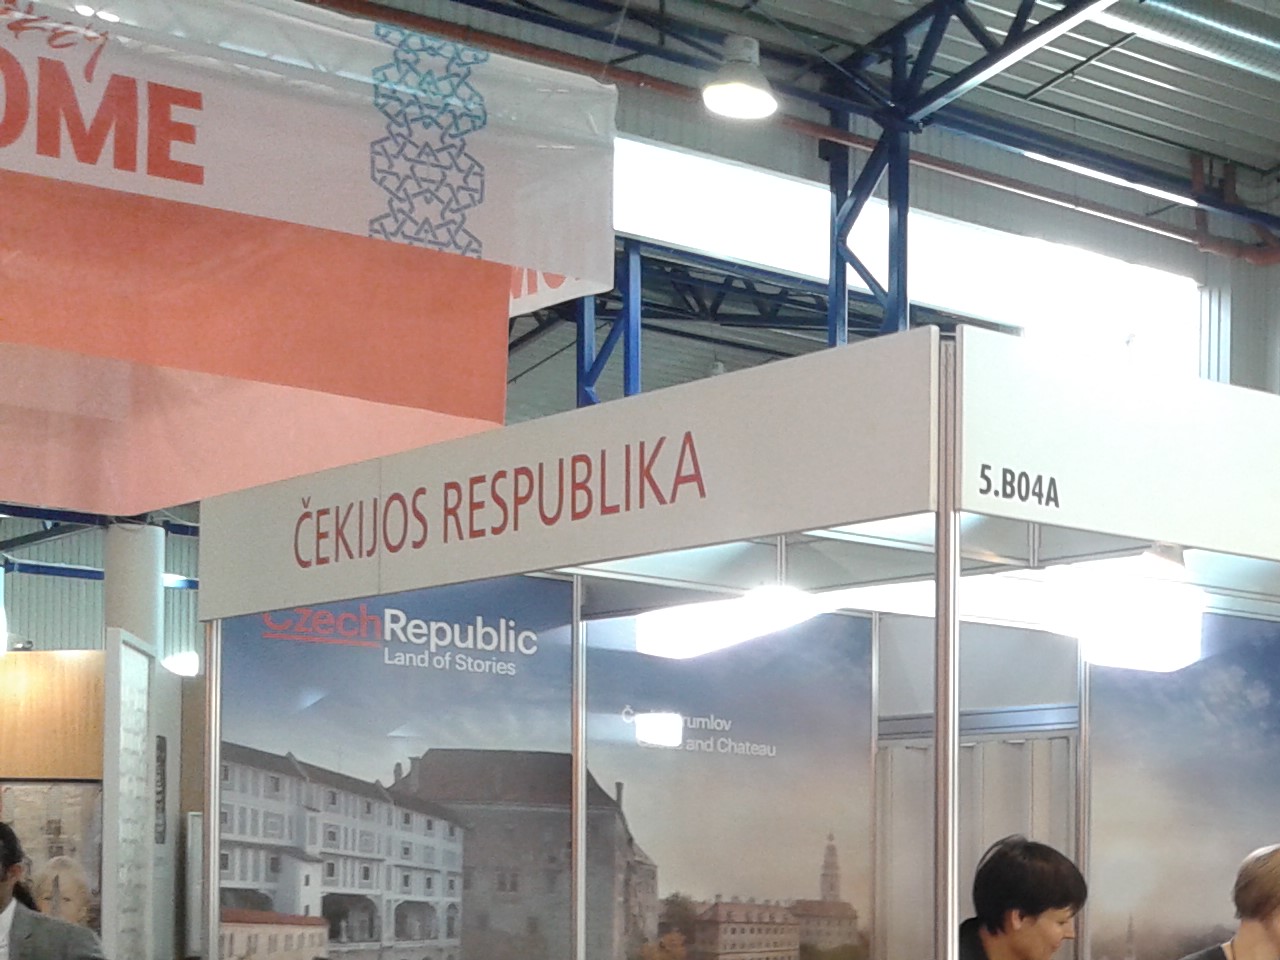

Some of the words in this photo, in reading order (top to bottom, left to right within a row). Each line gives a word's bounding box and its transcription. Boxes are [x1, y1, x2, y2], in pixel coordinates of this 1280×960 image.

[293, 487, 428, 569] ČEKIJOS
[442, 430, 706, 544] RESPUBLIKA
[979, 463, 1060, 508] 5.B04A
[384, 647, 429, 667] Land
[433, 650, 453, 670] of
[455, 653, 516, 676] Stories
[675, 712, 732, 731] rumlov
[686, 737, 715, 752] and
[717, 738, 777, 757] Chateau
